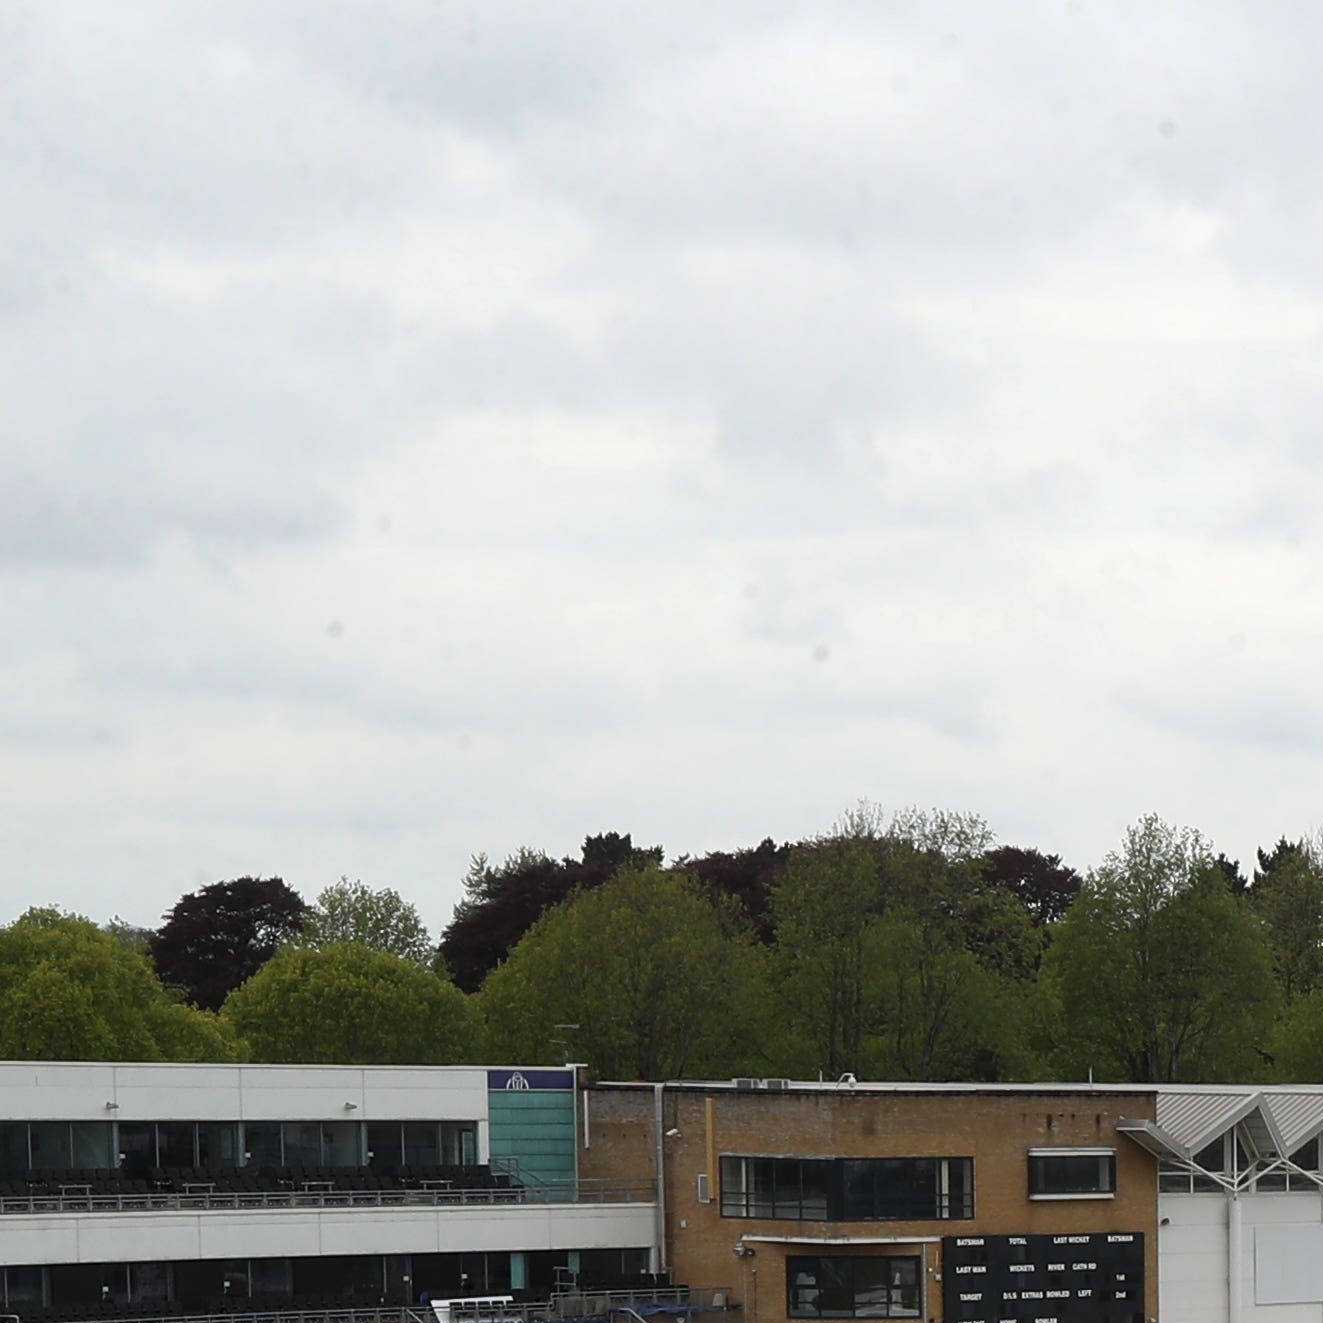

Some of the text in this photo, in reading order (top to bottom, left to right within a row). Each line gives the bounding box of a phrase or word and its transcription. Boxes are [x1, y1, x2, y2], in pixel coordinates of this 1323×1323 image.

[956, 1238, 985, 1246] BATSMAN
[1068, 1236, 1090, 1244] WICKET
[1108, 1235, 1134, 1243] BATSMAN
[956, 1266, 972, 1274] LAST
[1009, 1264, 1035, 1272] WICKETS
[1046, 1290, 1070, 1298] BOWLED
